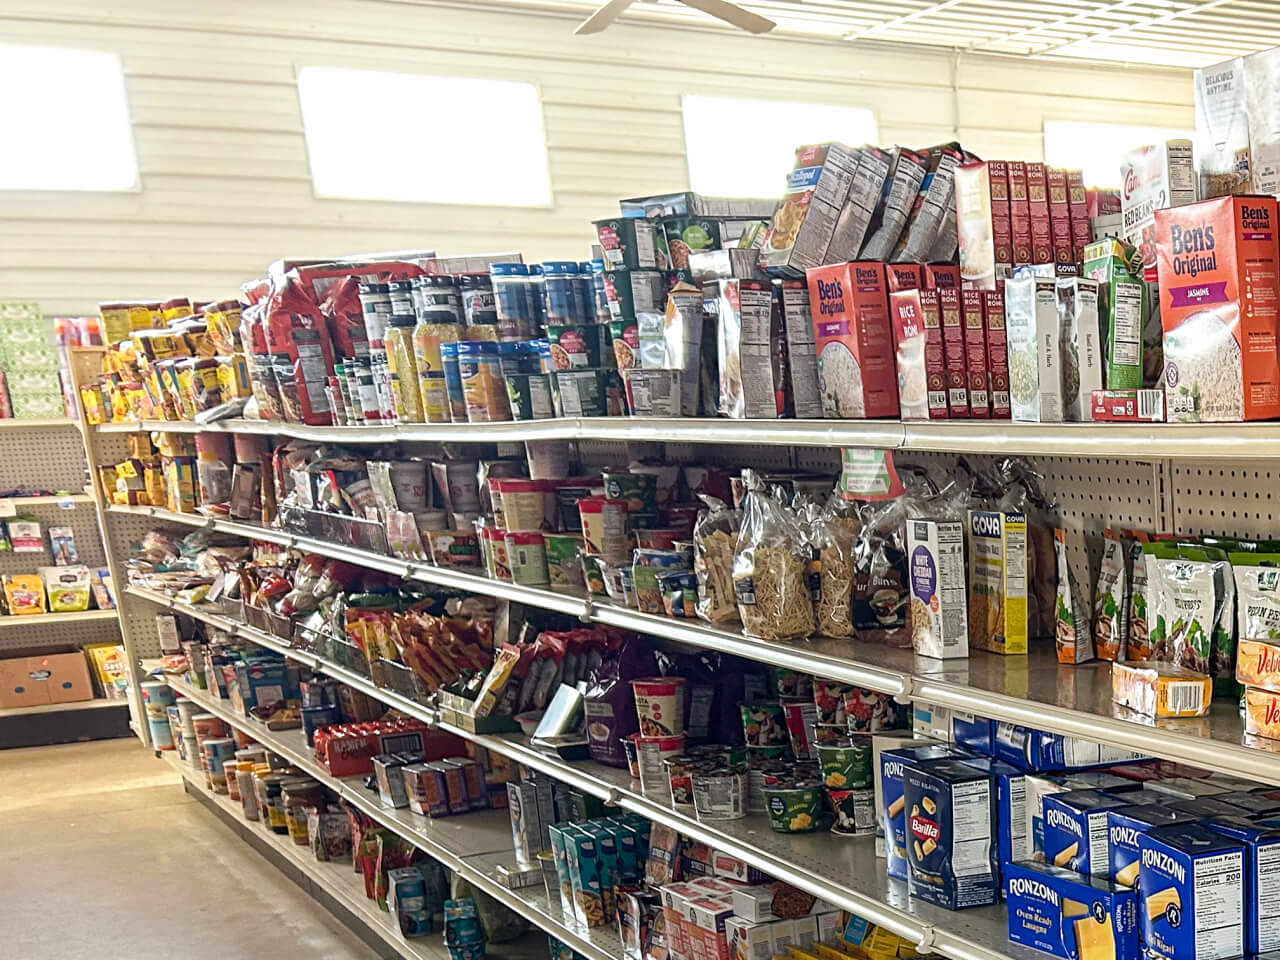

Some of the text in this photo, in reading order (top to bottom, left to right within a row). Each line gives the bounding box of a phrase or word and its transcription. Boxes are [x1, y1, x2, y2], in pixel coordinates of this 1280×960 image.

[1205, 71, 1234, 86] DELICIOUS
[1241, 206, 1269, 220] Ben's
[1242, 219, 1270, 229] Original
[1171, 220, 1215, 255] Ben's
[1057, 264, 1077, 273] GOYA
[1173, 250, 1217, 276] Original
[818, 277, 843, 300] Ben's
[1187, 287, 1210, 298] JASMINE
[820, 300, 845, 315] Original
[900, 305, 914, 318] RICE
[972, 516, 1000, 535] GOYA
[911, 820, 938, 838] Barilla
[1047, 808, 1083, 838] RONZONI
[1142, 848, 1187, 885] RONZONI
[1195, 857, 1223, 866] Nutrition
[1226, 872, 1240, 882] 200
[1009, 878, 1059, 907] RONZONI
[1022, 920, 1047, 935] Lasagna
